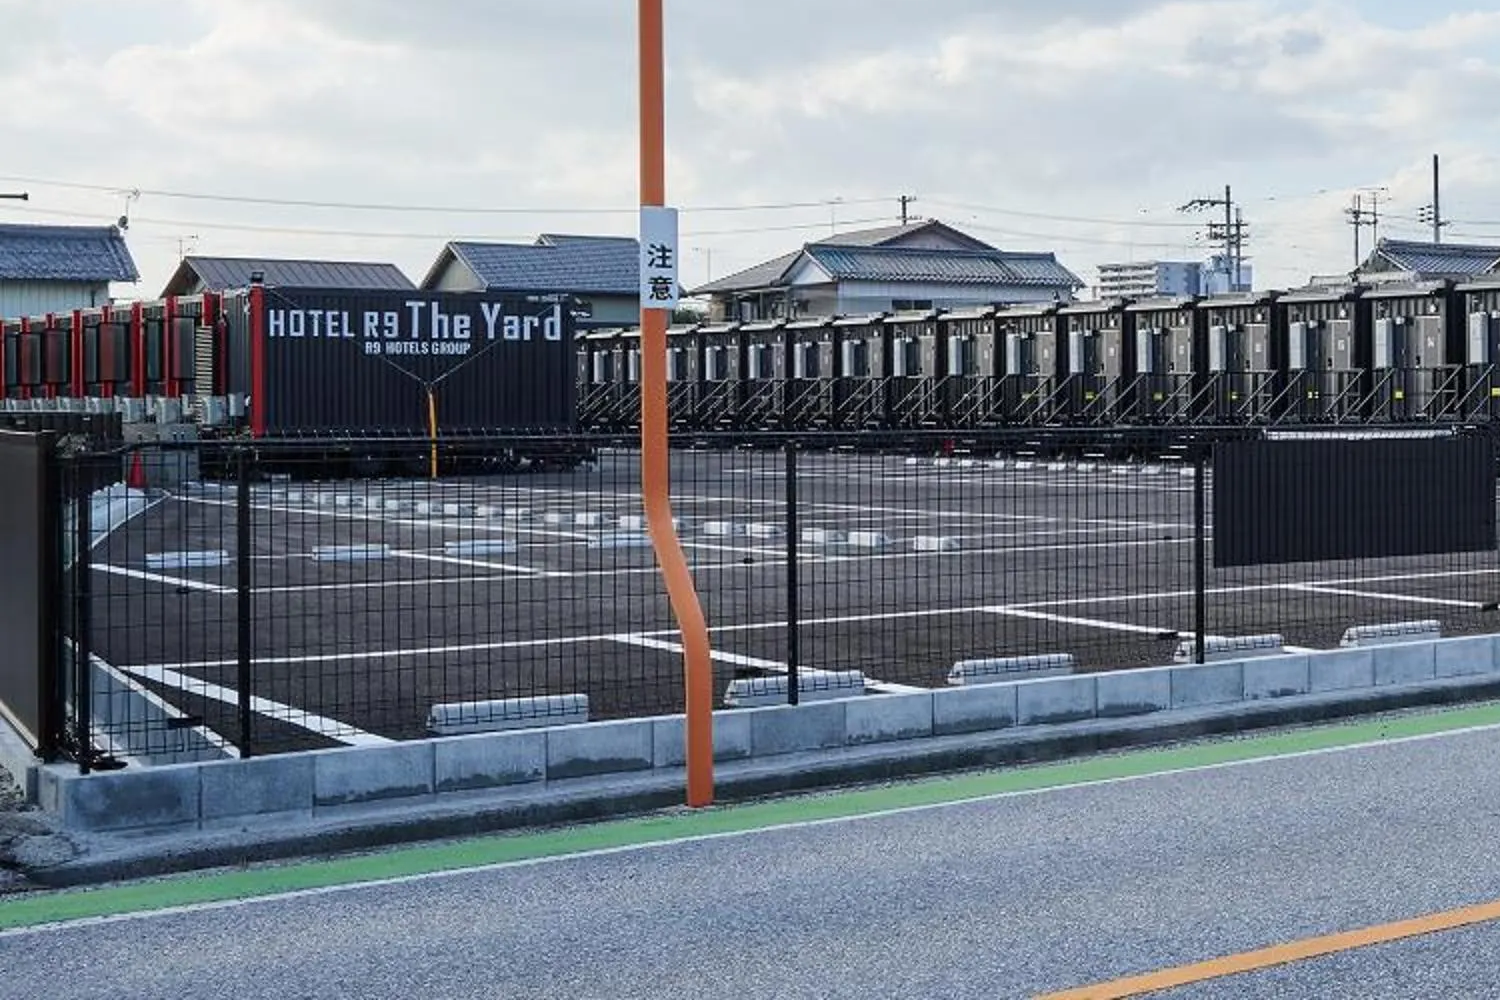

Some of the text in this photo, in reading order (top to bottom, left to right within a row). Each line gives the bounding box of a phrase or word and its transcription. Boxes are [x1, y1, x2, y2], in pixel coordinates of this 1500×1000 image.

[647, 243, 673, 300] 注意
[268, 301, 562, 341] HOTEL R9 The Yard
[365, 341, 471, 355] R9 HOTELS GROUP
